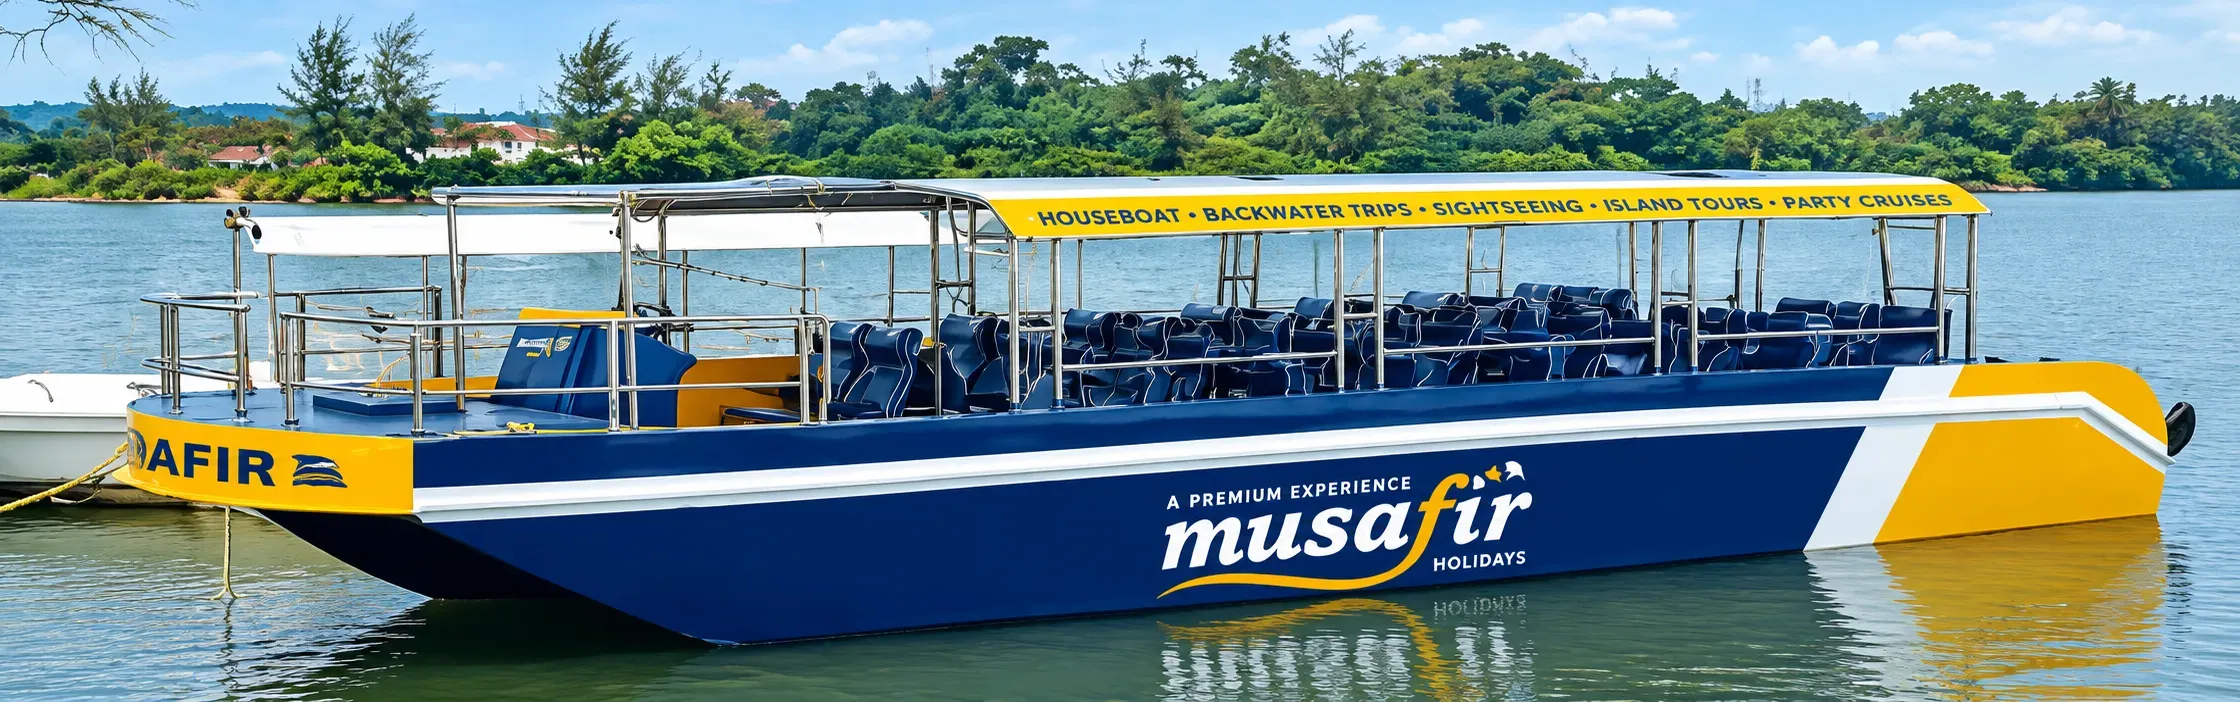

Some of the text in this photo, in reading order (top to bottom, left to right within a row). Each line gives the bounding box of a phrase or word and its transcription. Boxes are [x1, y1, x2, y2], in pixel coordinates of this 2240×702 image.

[1037, 194, 1953, 227] HOUSEBOAT BACKWATER TRIPS SIGHTSEEING ISLAND TOURS PARTY CRUISES
[147, 438, 276, 487] AFIR
[1166, 476, 1411, 510] A PREMIUM EXPERIENCE
[1158, 473, 1533, 599] musafir
[1433, 550, 1526, 572] HOLIDAYS
